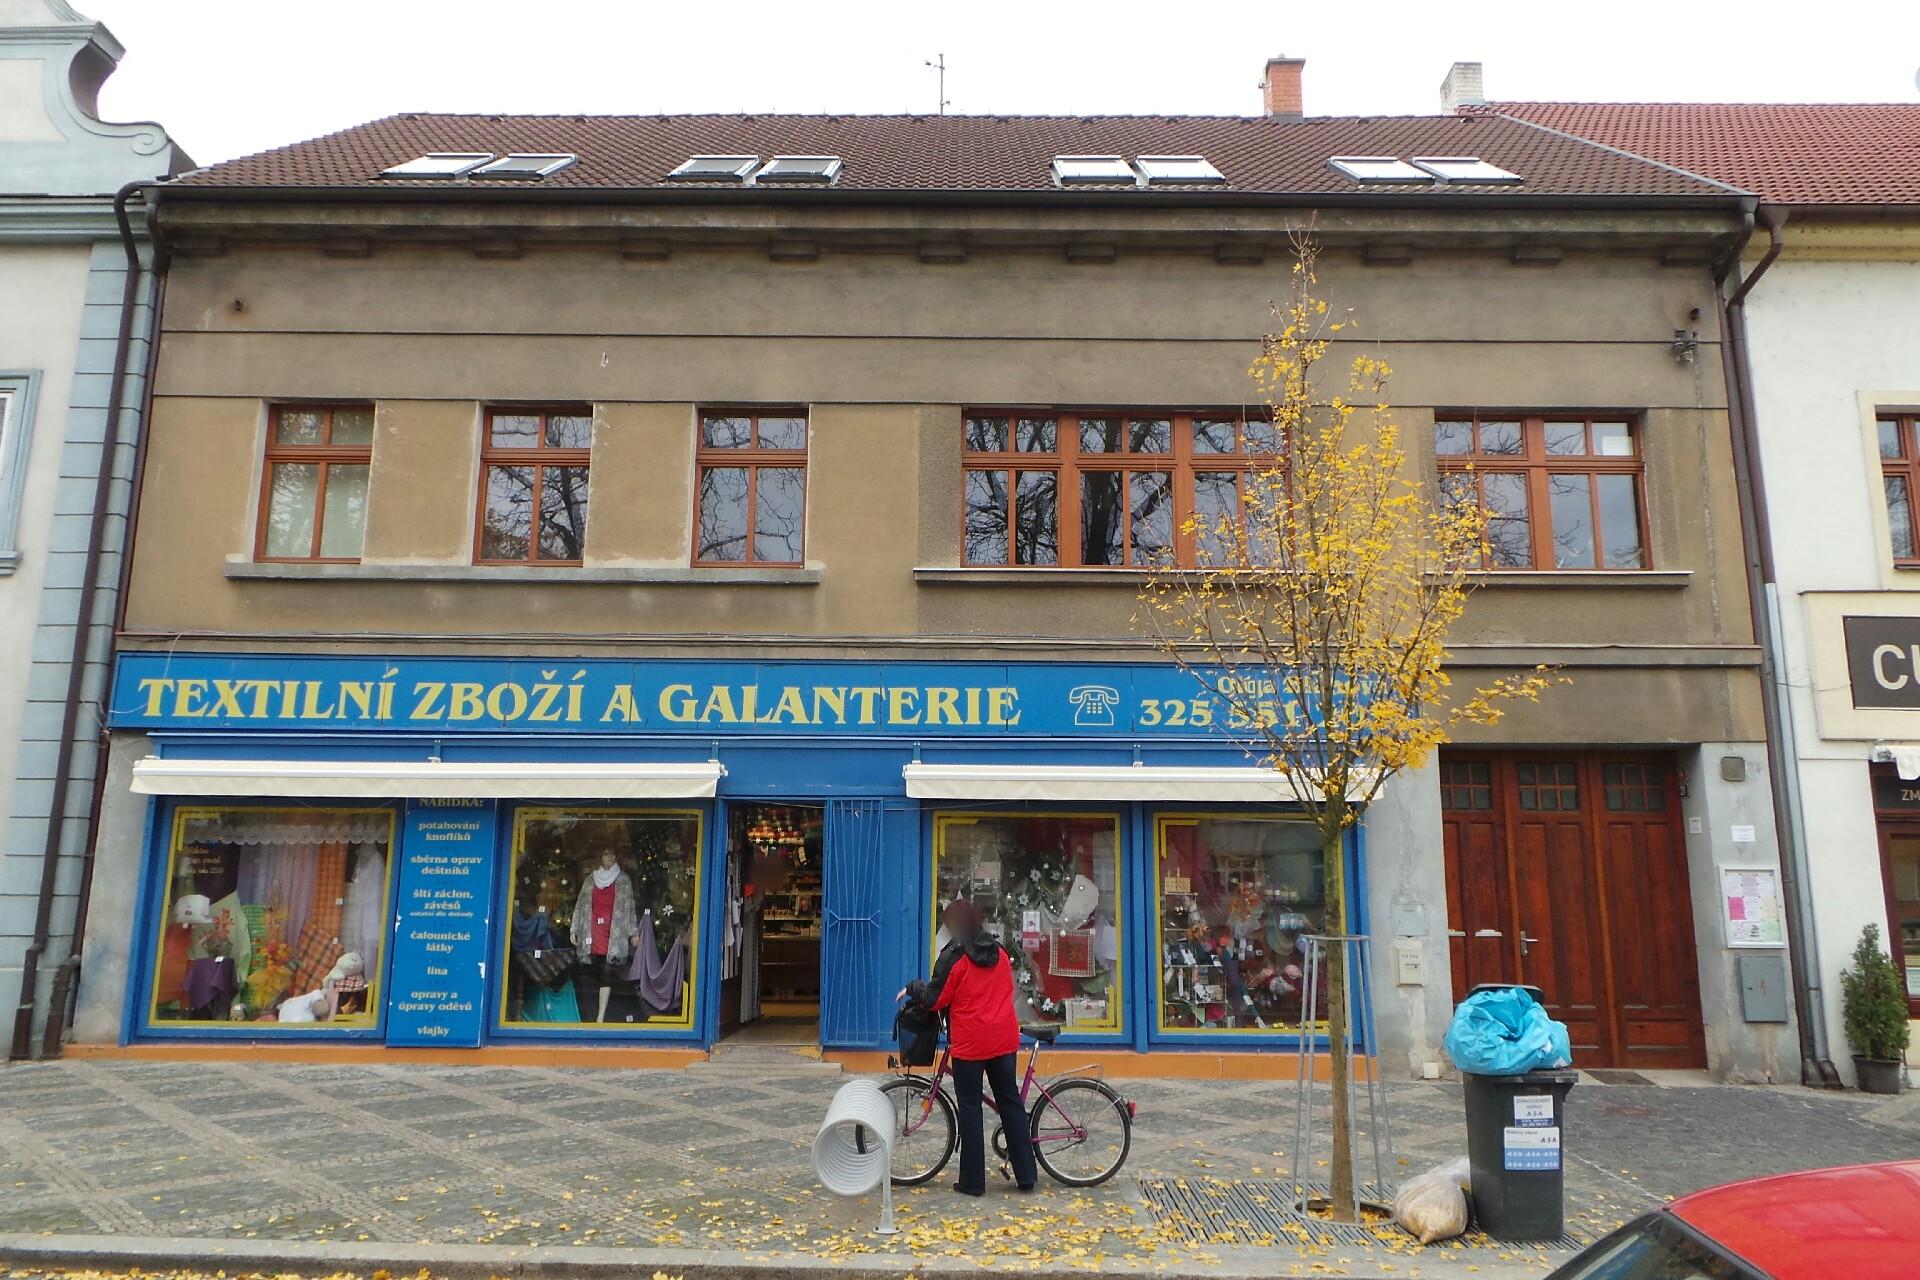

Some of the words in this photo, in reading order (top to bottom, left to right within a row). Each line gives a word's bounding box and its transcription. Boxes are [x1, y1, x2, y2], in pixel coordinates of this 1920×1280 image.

[1872, 644, 1920, 690] C
[138, 667, 400, 719] TEXTILNÍ
[409, 668, 587, 722] ZBOŽÍ
[600, 685, 642, 723] A
[658, 684, 1022, 726] GALANTERIE
[1139, 699, 1213, 727] 325
[418, 821, 481, 831] potahování
[426, 832, 471, 841] knoflíků
[410, 855, 448, 864] sběrna
[451, 856, 483, 865] oprav
[421, 866, 469, 875] deštníků
[413, 889, 432, 898] šití
[424, 901, 461, 910] závěsů
[410, 931, 471, 941] čalounické
[426, 943, 454, 954] látky
[411, 991, 448, 1000] opravy
[451, 991, 458, 999] a
[398, 1001, 435, 1013] úpravy
[438, 1002, 472, 1011] oděvů
[417, 1025, 450, 1036] vlajky
